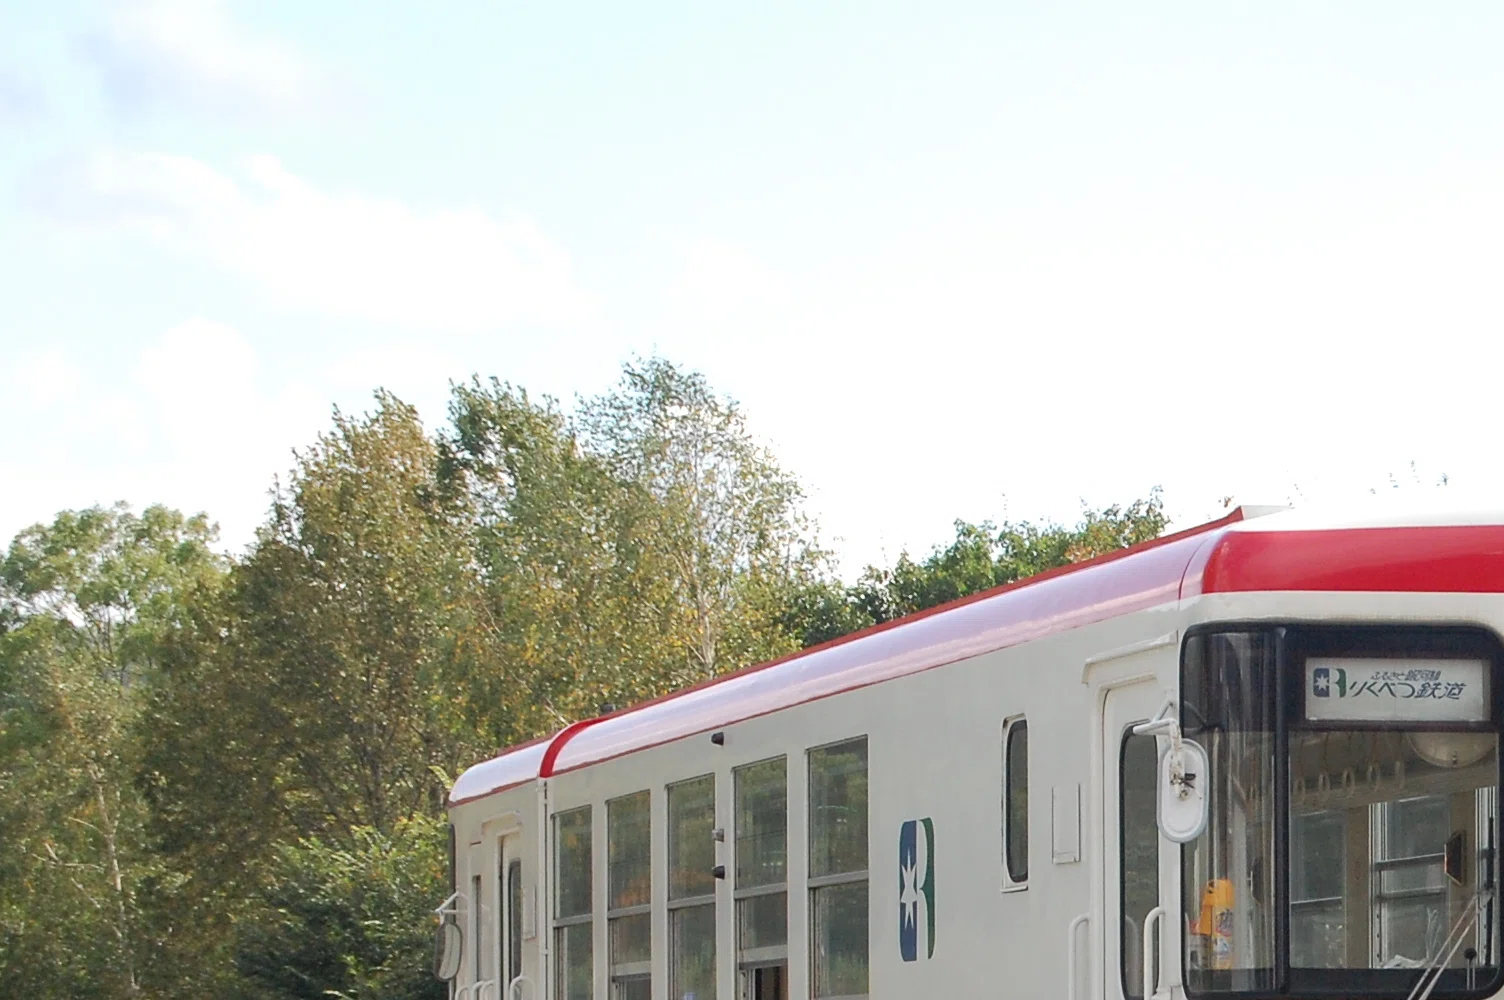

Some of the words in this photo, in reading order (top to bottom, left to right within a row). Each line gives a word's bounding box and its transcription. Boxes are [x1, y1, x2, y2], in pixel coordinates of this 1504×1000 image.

[1349, 680, 1467, 700] りくべつ鉄道
